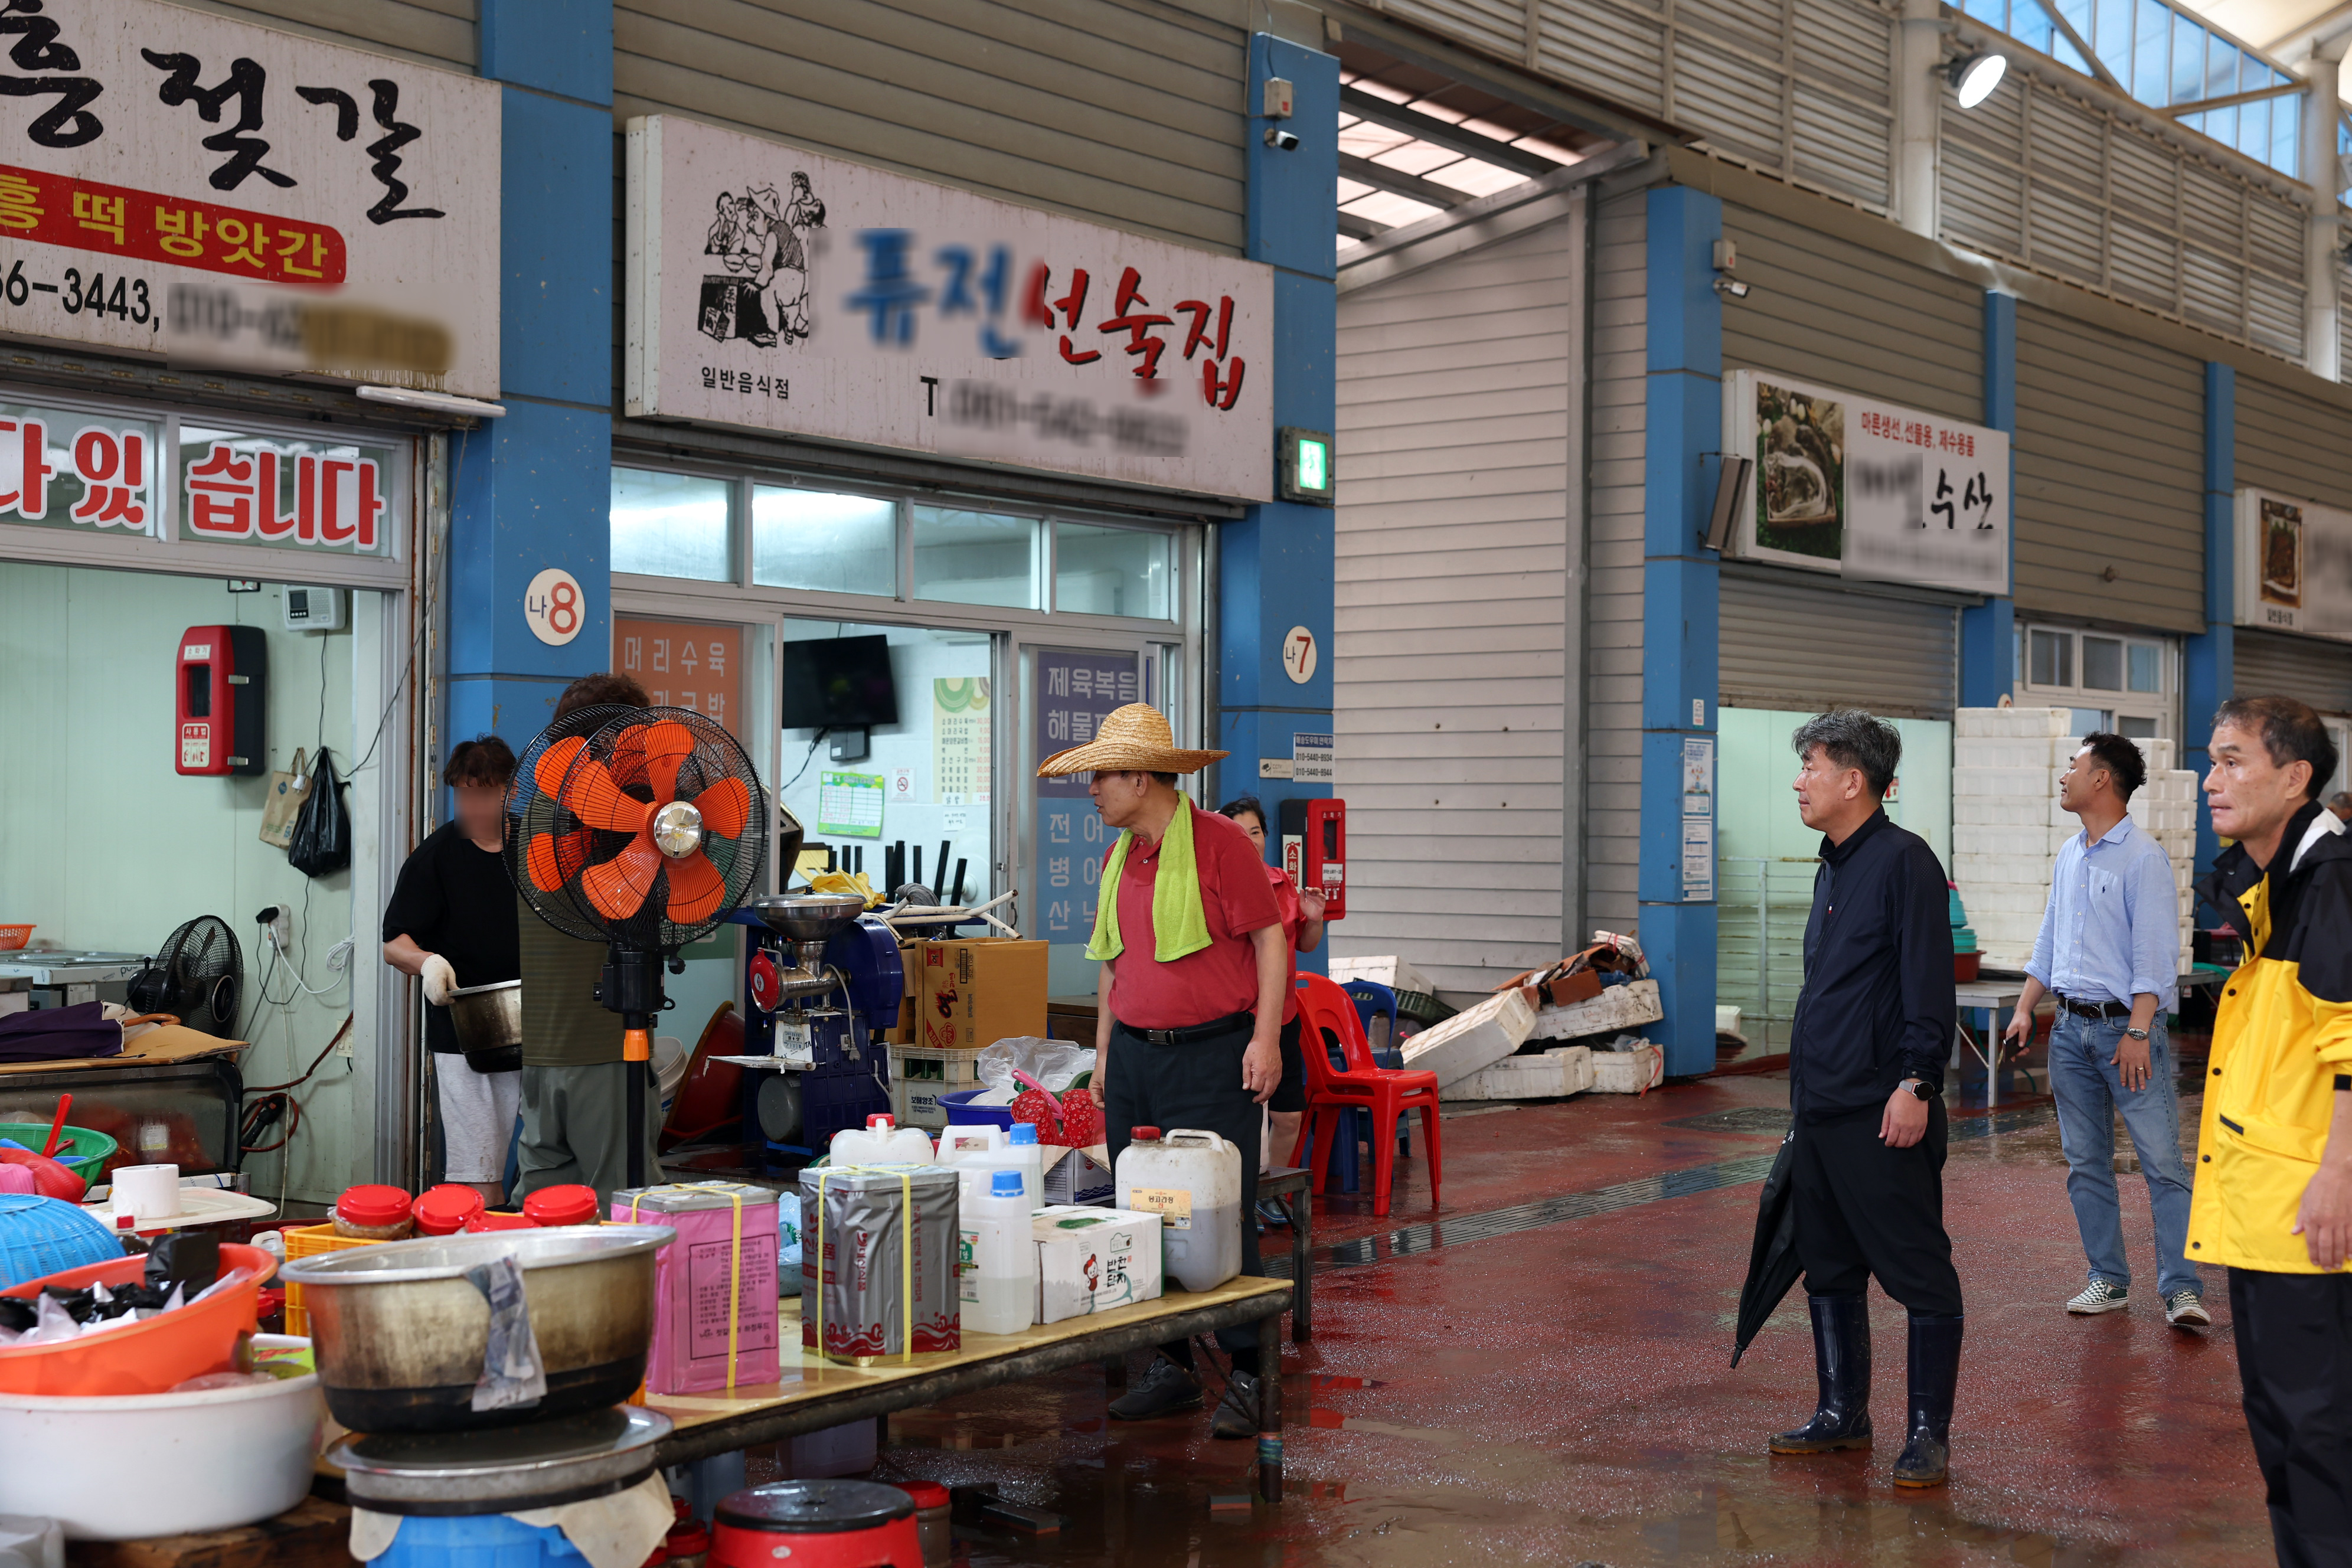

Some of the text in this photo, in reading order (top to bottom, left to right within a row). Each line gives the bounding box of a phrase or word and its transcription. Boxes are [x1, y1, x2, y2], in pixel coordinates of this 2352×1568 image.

[73, 191, 125, 246] 떡
[155, 205, 329, 279] 방앗간
[0, 260, 160, 333] 6-3443,
[701, 366, 789, 400] 일반음식점
[1048, 667, 1138, 701] 제육복음
[1288, 849, 1298, 884] 소화기
[911, 1096, 933, 1105] 보해양조
[1107, 1256, 1127, 1273] 반찬
[1107, 1273, 1126, 1288] 단지
